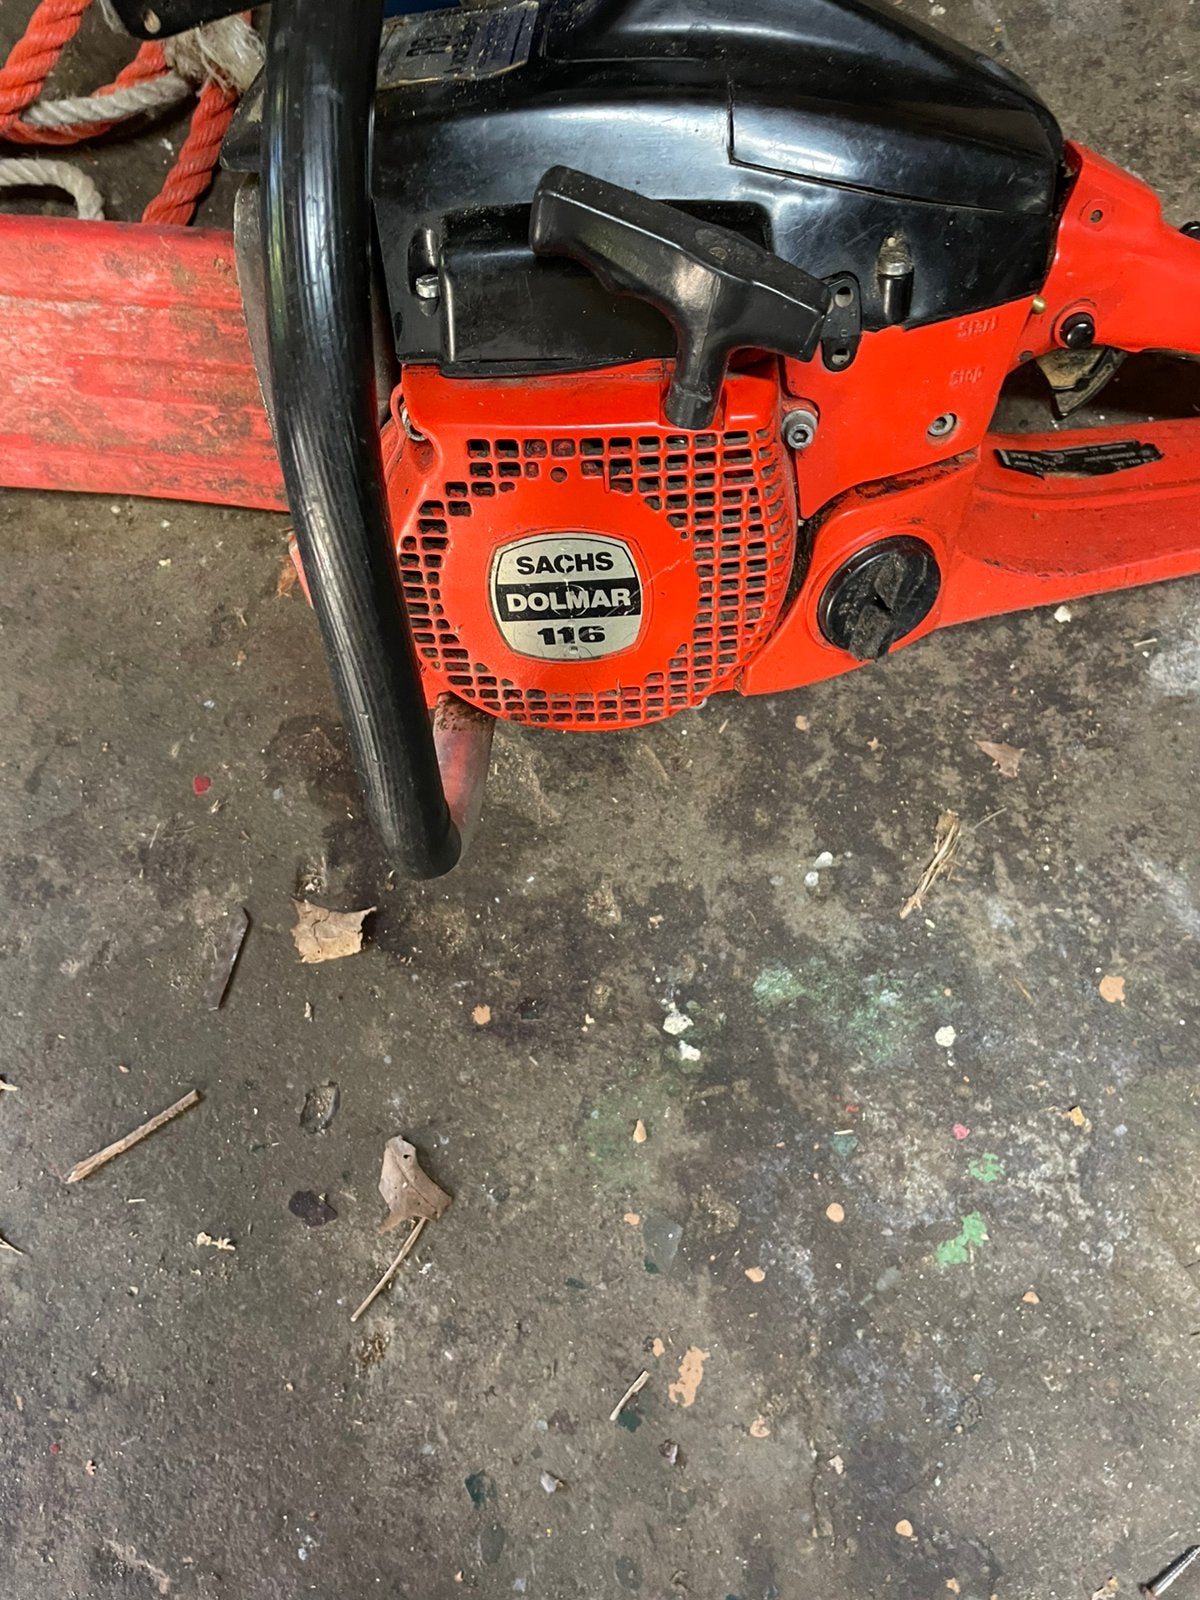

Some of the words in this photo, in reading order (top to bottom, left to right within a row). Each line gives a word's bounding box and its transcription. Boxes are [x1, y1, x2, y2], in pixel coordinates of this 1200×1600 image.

[516, 552, 614, 575] SACHS
[505, 588, 632, 613] DOLMAR
[537, 625, 606, 646] 116
